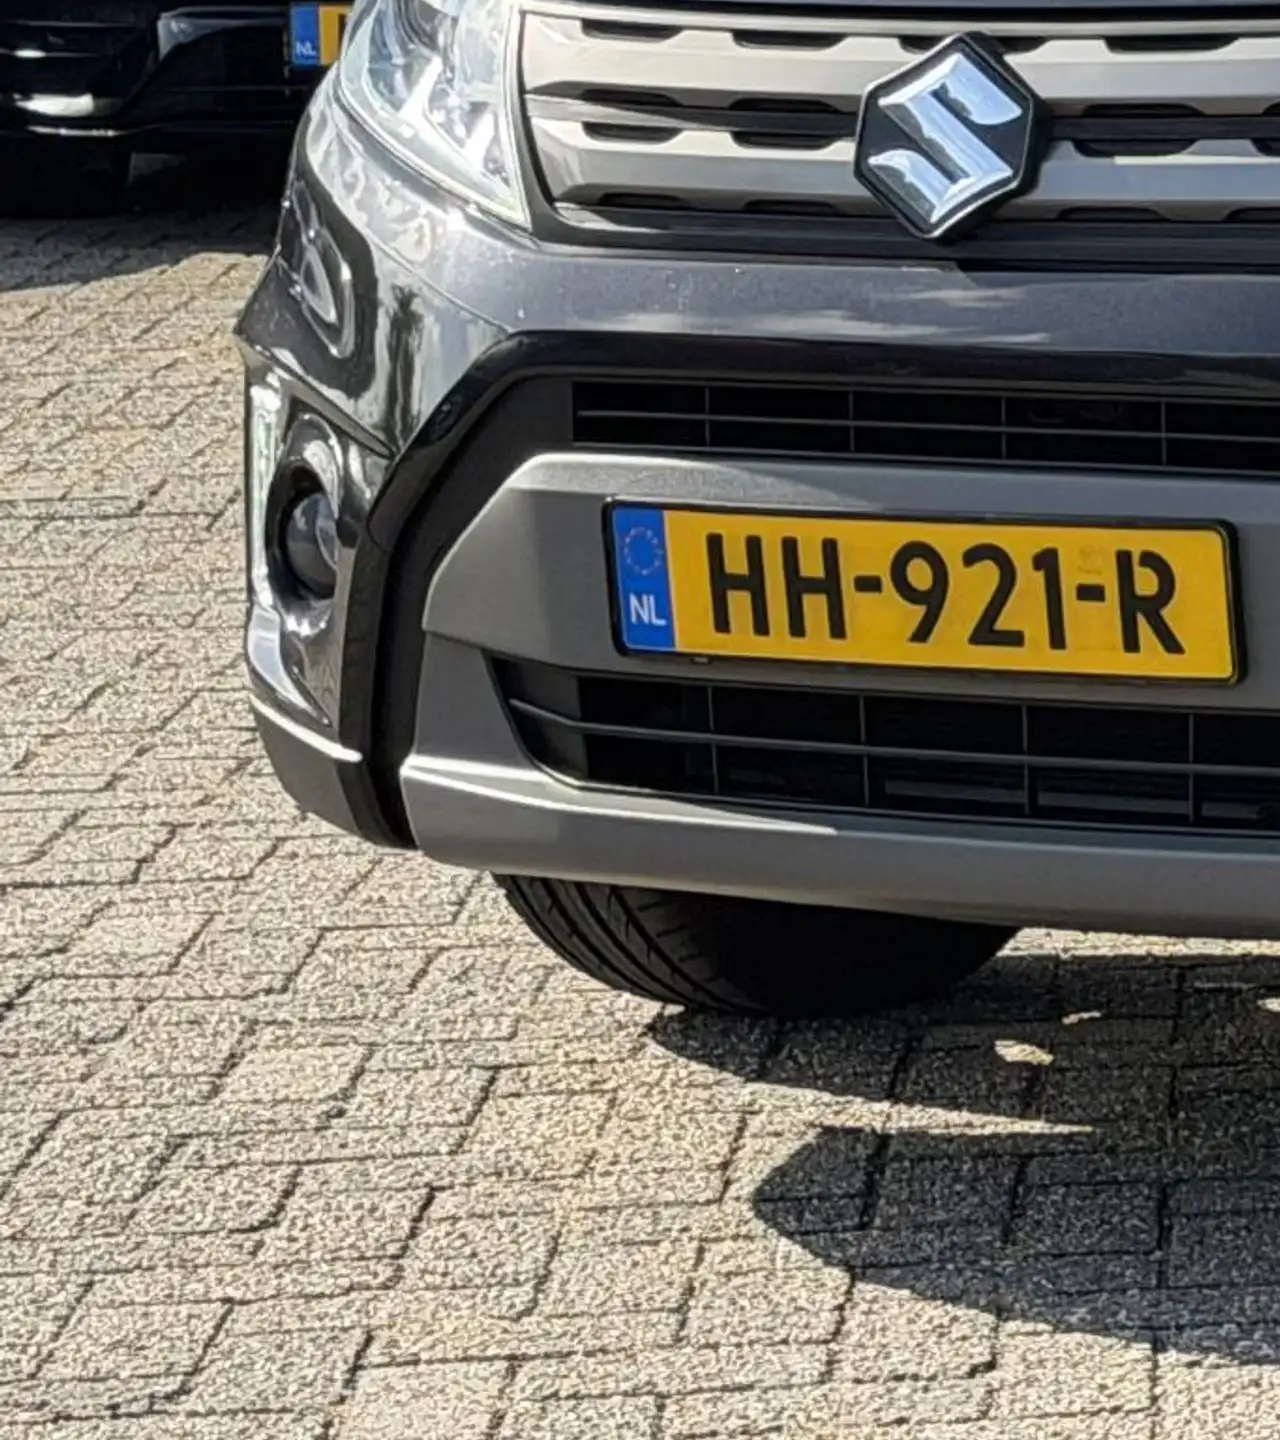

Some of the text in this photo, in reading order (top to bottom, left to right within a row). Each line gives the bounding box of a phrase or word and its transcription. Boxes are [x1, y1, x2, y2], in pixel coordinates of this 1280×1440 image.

[295, 40, 317, 57] NL
[629, 531, 1185, 655] NL HH-921-R
